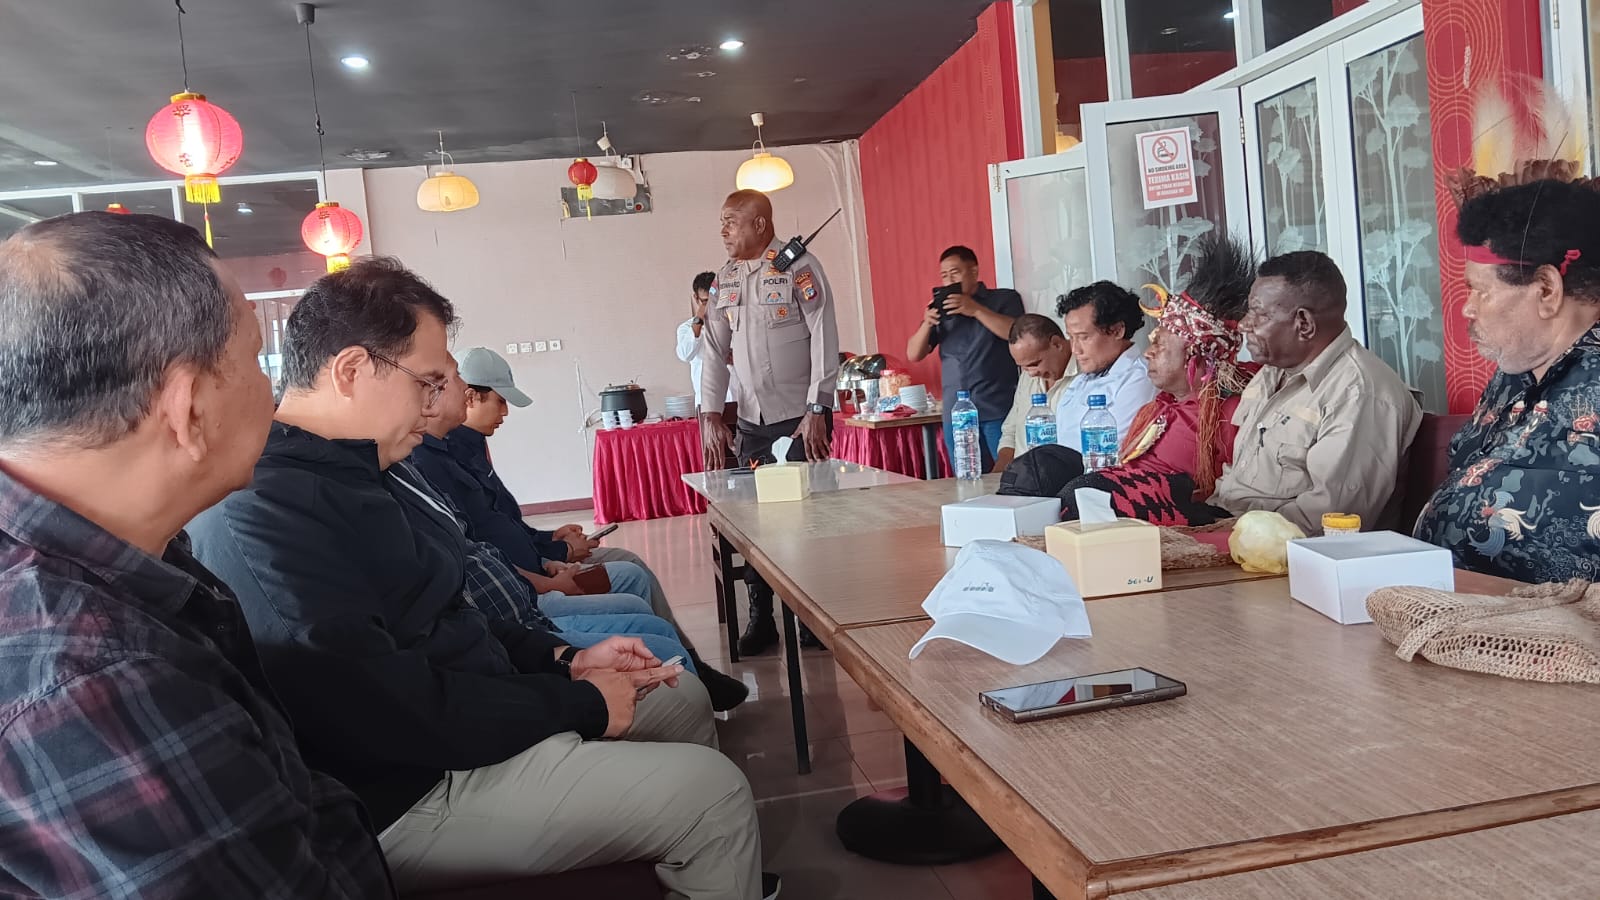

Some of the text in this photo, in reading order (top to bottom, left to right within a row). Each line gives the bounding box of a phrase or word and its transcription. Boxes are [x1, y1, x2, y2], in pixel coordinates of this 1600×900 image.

[1155, 165, 1175, 173] SMOKING
[1148, 174, 1170, 184] TERIMA
[763, 277, 788, 286] POLRI
